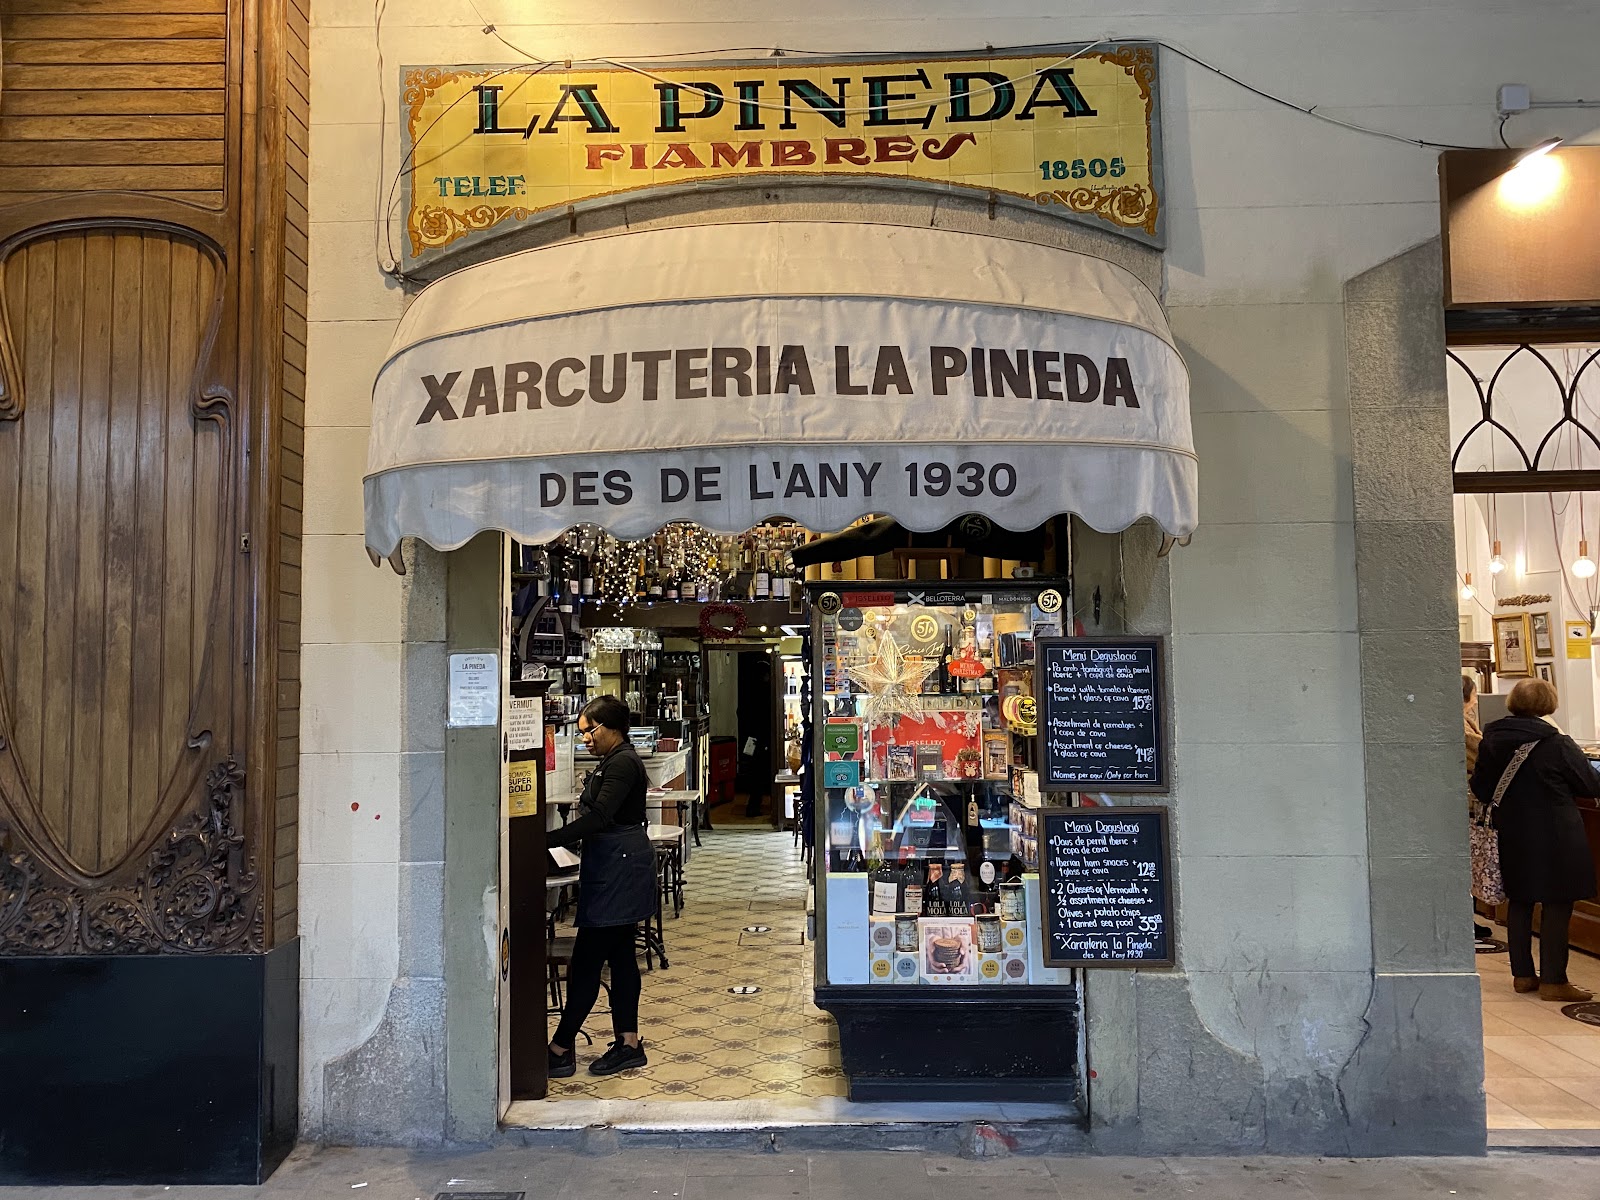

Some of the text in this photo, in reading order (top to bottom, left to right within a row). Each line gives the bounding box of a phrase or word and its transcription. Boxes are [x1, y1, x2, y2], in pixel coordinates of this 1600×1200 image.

[473, 67, 1097, 139] LA PINEDA
[585, 132, 979, 171] FIAMBRES
[1039, 157, 1127, 181] 18505
[433, 175, 526, 198] TELEF.
[415, 345, 1141, 425] XARCUTERIA LA PINEDA
[539, 461, 1018, 509] DES DE L'ANY 1930
[509, 699, 533, 709] VERMUT
[509, 784, 532, 793] GOLD
